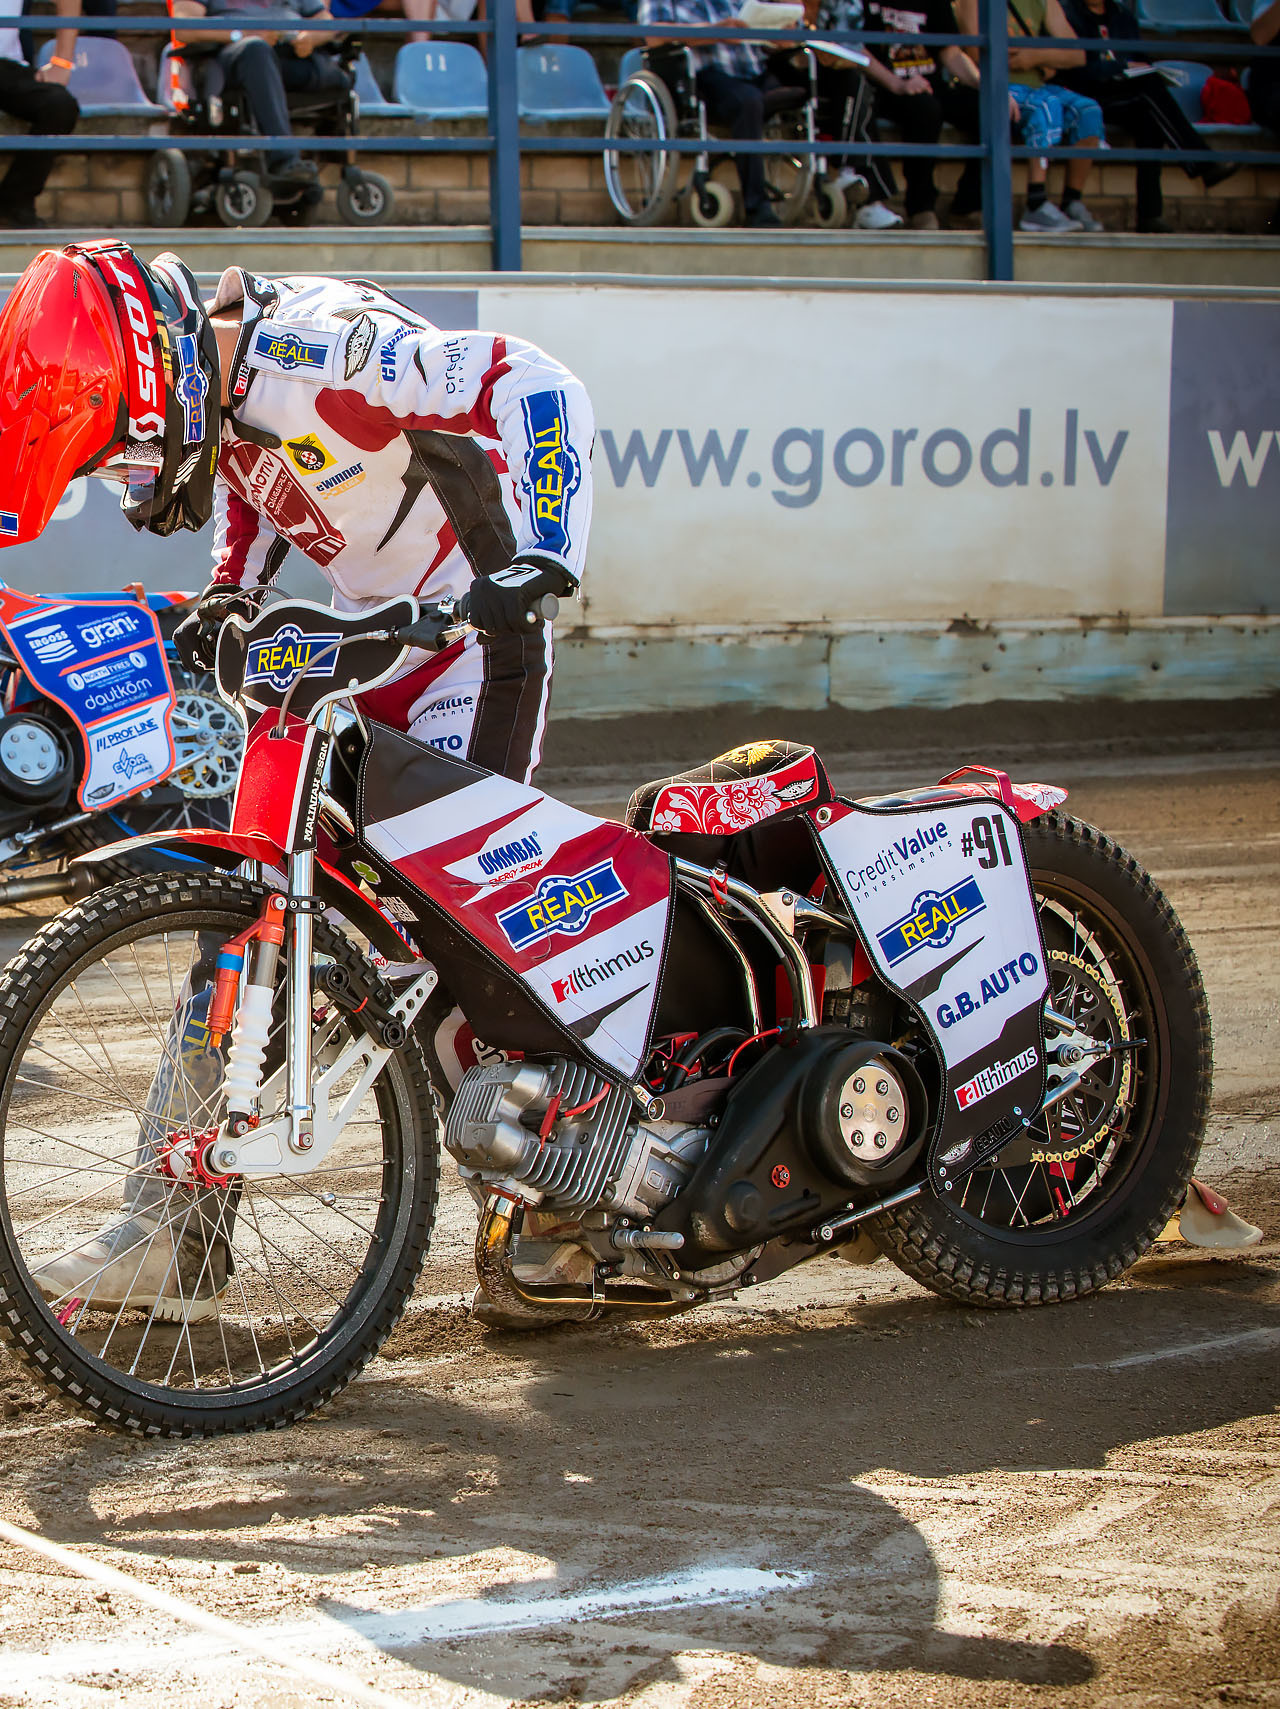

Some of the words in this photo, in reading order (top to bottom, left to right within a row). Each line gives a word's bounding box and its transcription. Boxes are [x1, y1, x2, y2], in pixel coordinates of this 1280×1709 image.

[266, 340, 314, 363] REALL
[535, 417, 563, 522] REALL
[599, 409, 1129, 508] ww.gorod.lv
[28, 630, 69, 650] ERGOSS
[84, 678, 153, 710] dautkōm
[960, 813, 1013, 870] #91
[526, 880, 603, 931] REALL
[899, 895, 969, 948] REALL
[554, 939, 655, 1001] althimus
[936, 992, 980, 1029] G.B.
[980, 952, 1039, 1005] AUTO
[962, 1047, 1038, 1107] althimus
